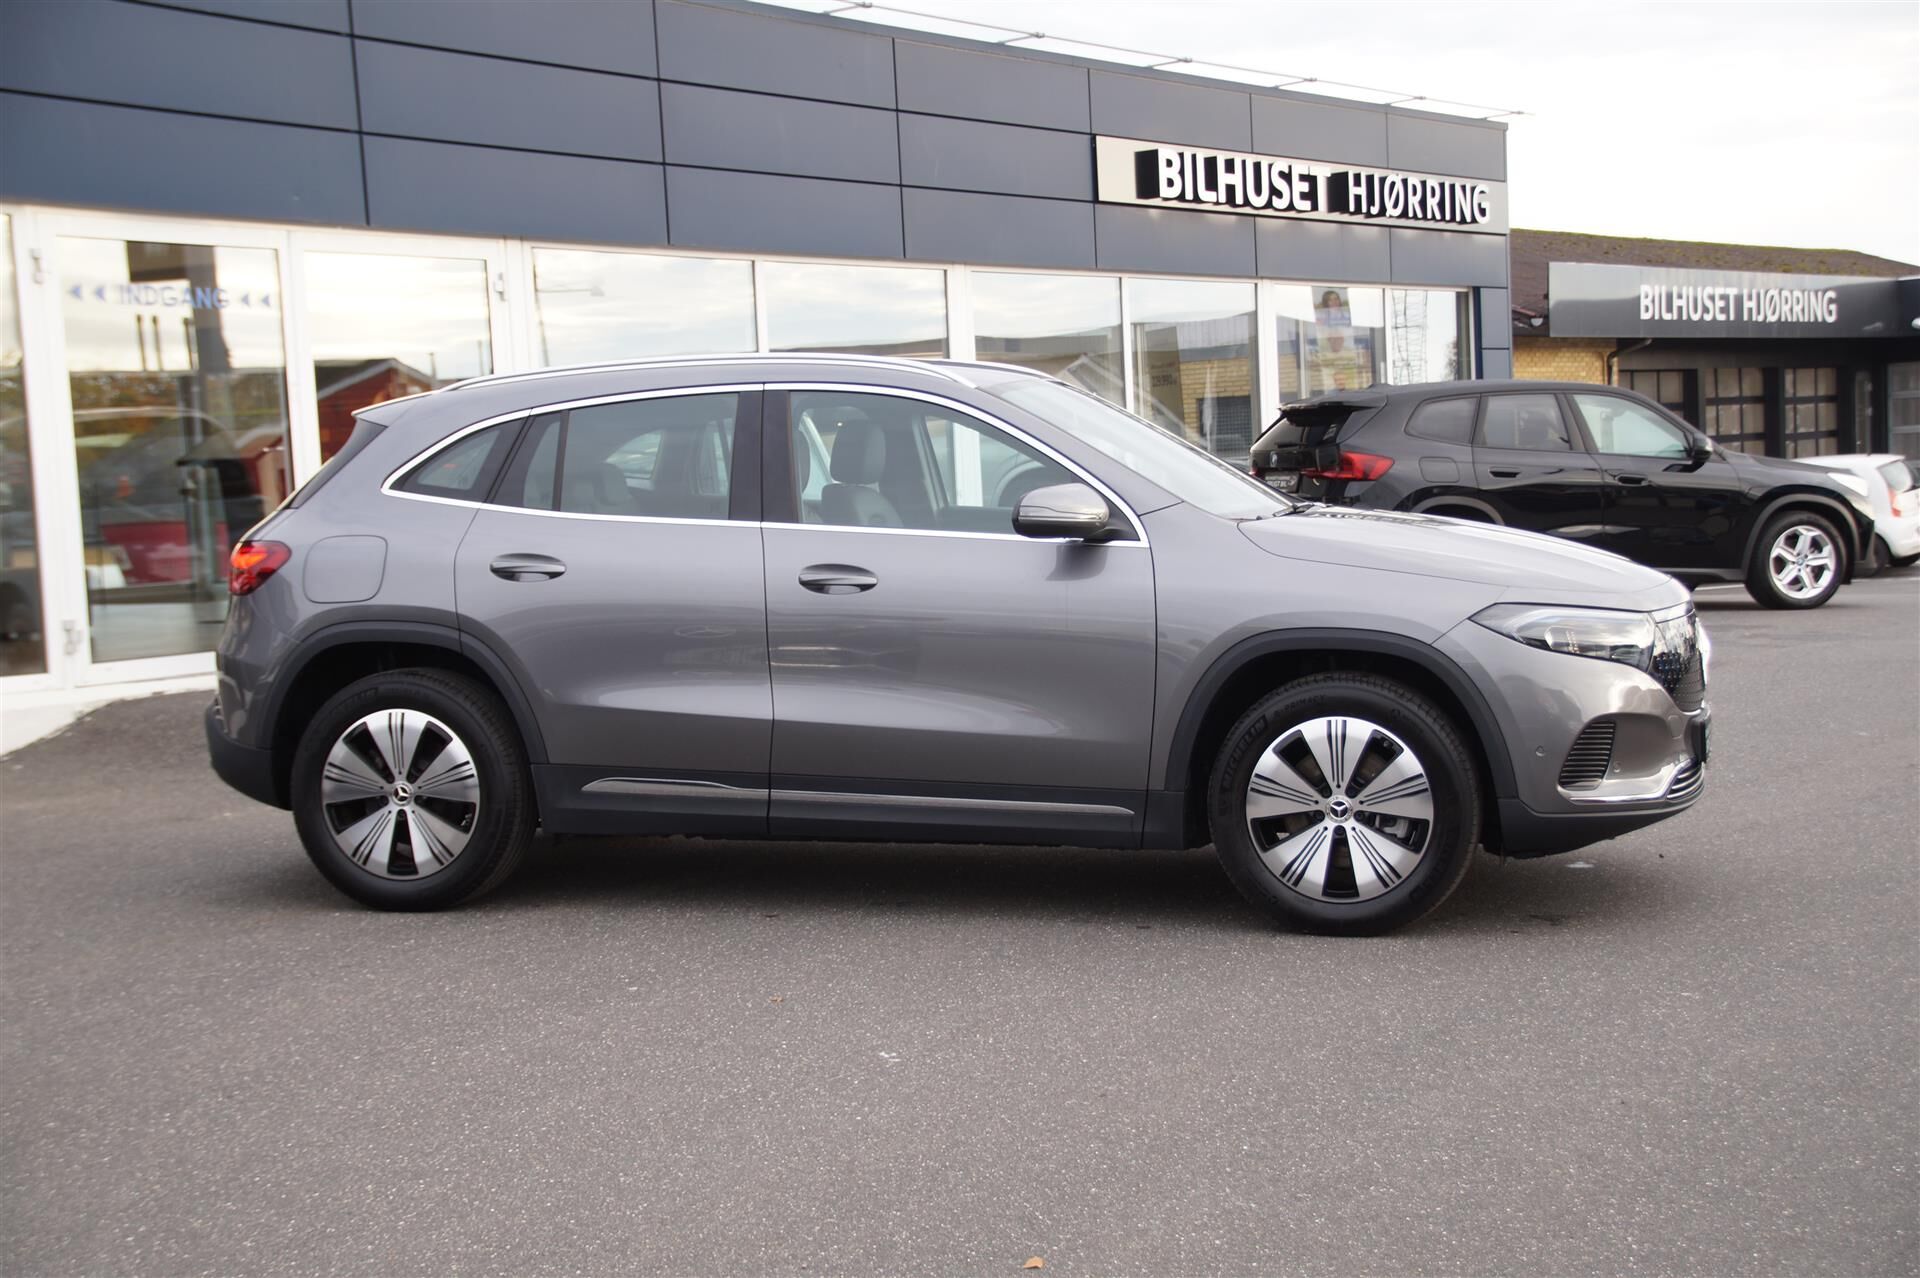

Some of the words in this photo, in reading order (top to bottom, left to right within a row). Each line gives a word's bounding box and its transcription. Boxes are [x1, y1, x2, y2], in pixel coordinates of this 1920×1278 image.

[1157, 147, 1332, 213] BILHUSET
[1347, 169, 1490, 224] HJØRRING
[118, 284, 230, 310] INDGANG
[1639, 284, 1738, 322] BILHUSET
[1743, 288, 1837, 323] HJØRRING
